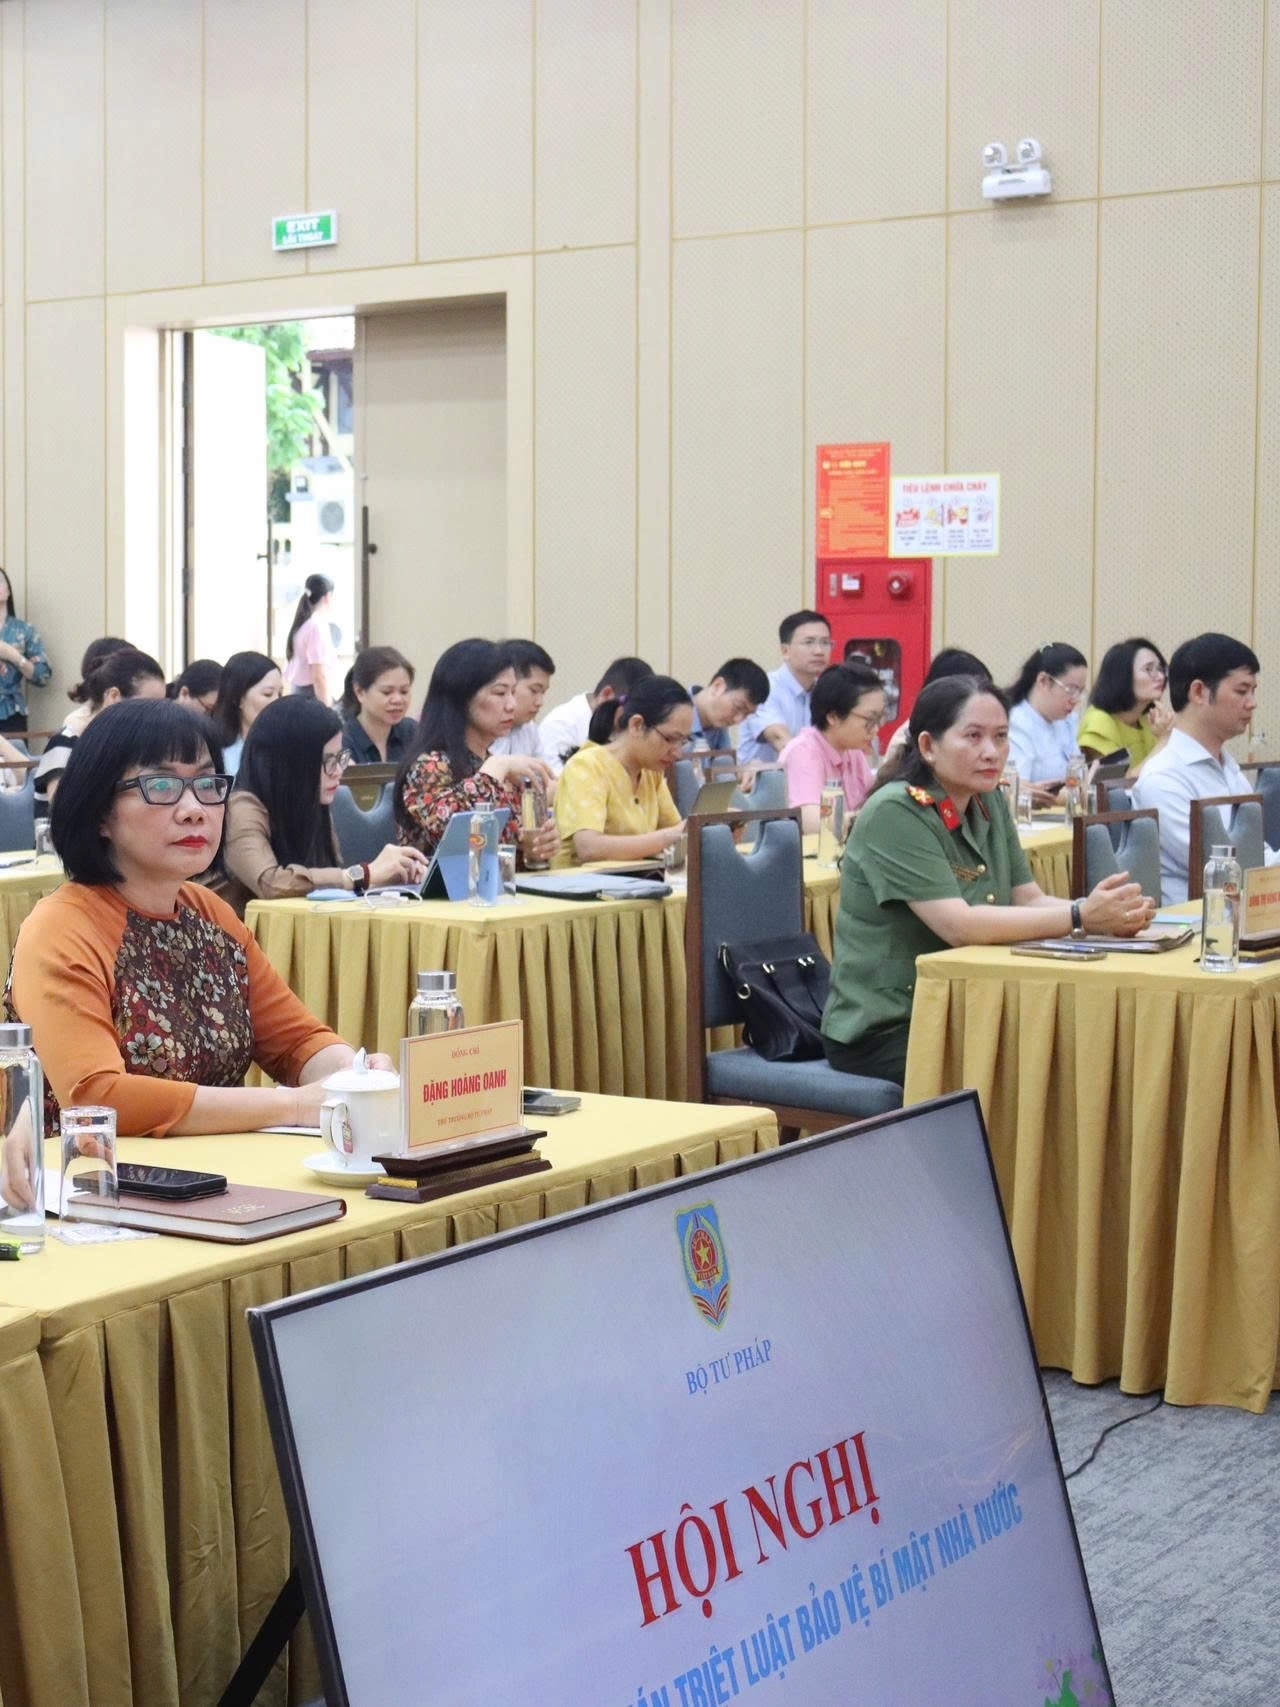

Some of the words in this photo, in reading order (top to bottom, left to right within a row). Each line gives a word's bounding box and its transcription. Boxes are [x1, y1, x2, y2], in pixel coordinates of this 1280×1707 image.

[423, 1079, 449, 1105] ĐẶNG
[450, 1073, 481, 1098] HOÀNG
[483, 1069, 507, 1091] OANH
[685, 1363, 708, 1395] BỘ
[708, 1351, 731, 1384] TƯ
[733, 1337, 772, 1374] PHÁP
[624, 1499, 744, 1628] HỘI
[741, 1430, 881, 1565] NGHỊ
[740, 1612, 796, 1687] LUẬT
[795, 1581, 842, 1654] BẢO
[840, 1563, 871, 1628] VỆ
[869, 1547, 894, 1609] BÍ
[892, 1530, 936, 1595] MẬT
[934, 1503, 977, 1569] NHÀ
[973, 1480, 1024, 1545] NƯỚC
